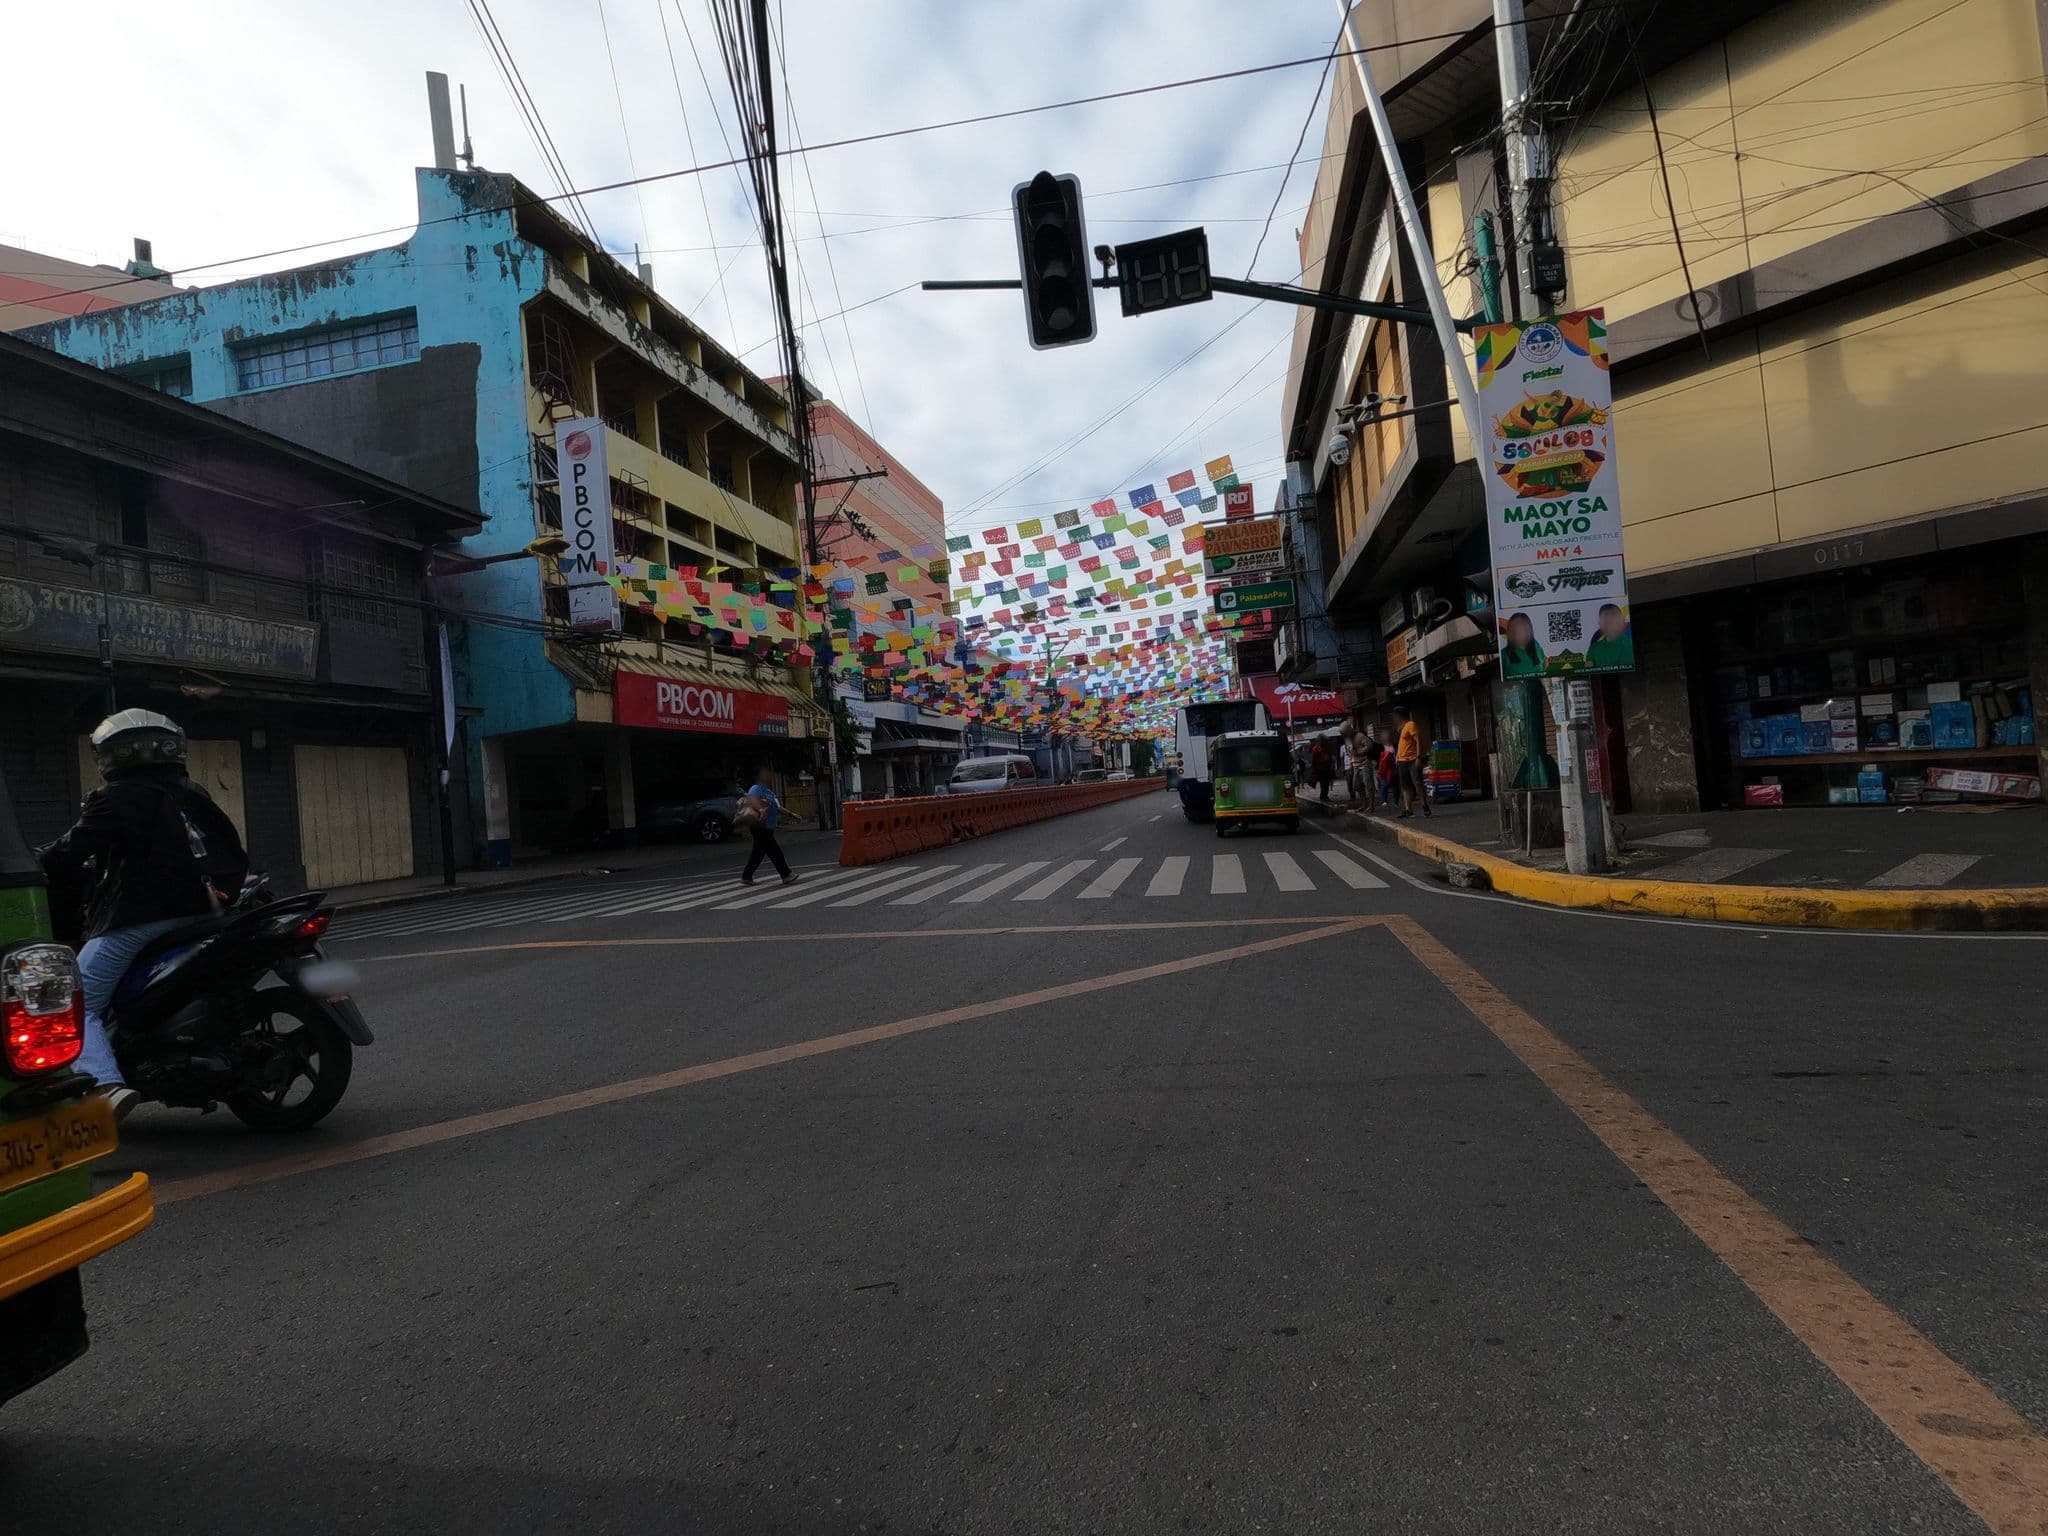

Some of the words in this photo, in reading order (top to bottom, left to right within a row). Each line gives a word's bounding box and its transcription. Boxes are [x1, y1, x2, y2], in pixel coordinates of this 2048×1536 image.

[1522, 365, 1564, 383] Fiesta!
[573, 462, 598, 574] PBCOM
[1504, 500, 1573, 524] MAOY
[1577, 496, 1608, 515] SA
[1216, 522, 1279, 540] PALAWAN
[1522, 516, 1591, 540] MAYO
[1205, 533, 1280, 555] PAWNSHOP
[1498, 543, 1516, 552] WITH
[1516, 542, 1534, 550] JUAN
[1535, 538, 1563, 547] KARLOS
[1563, 536, 1579, 545] AND
[1580, 532, 1620, 543] FREESTYLE
[1237, 557, 1280, 567] EXPRESS
[1536, 546, 1570, 560] MAY
[1573, 545, 1583, 556] 4
[1558, 566, 1585, 575] BOHOL
[1547, 569, 1614, 592] Tropics
[1239, 590, 1288, 604] PalawanPay
[656, 682, 735, 720] PBCOM
[1298, 691, 1337, 702] EVERY
